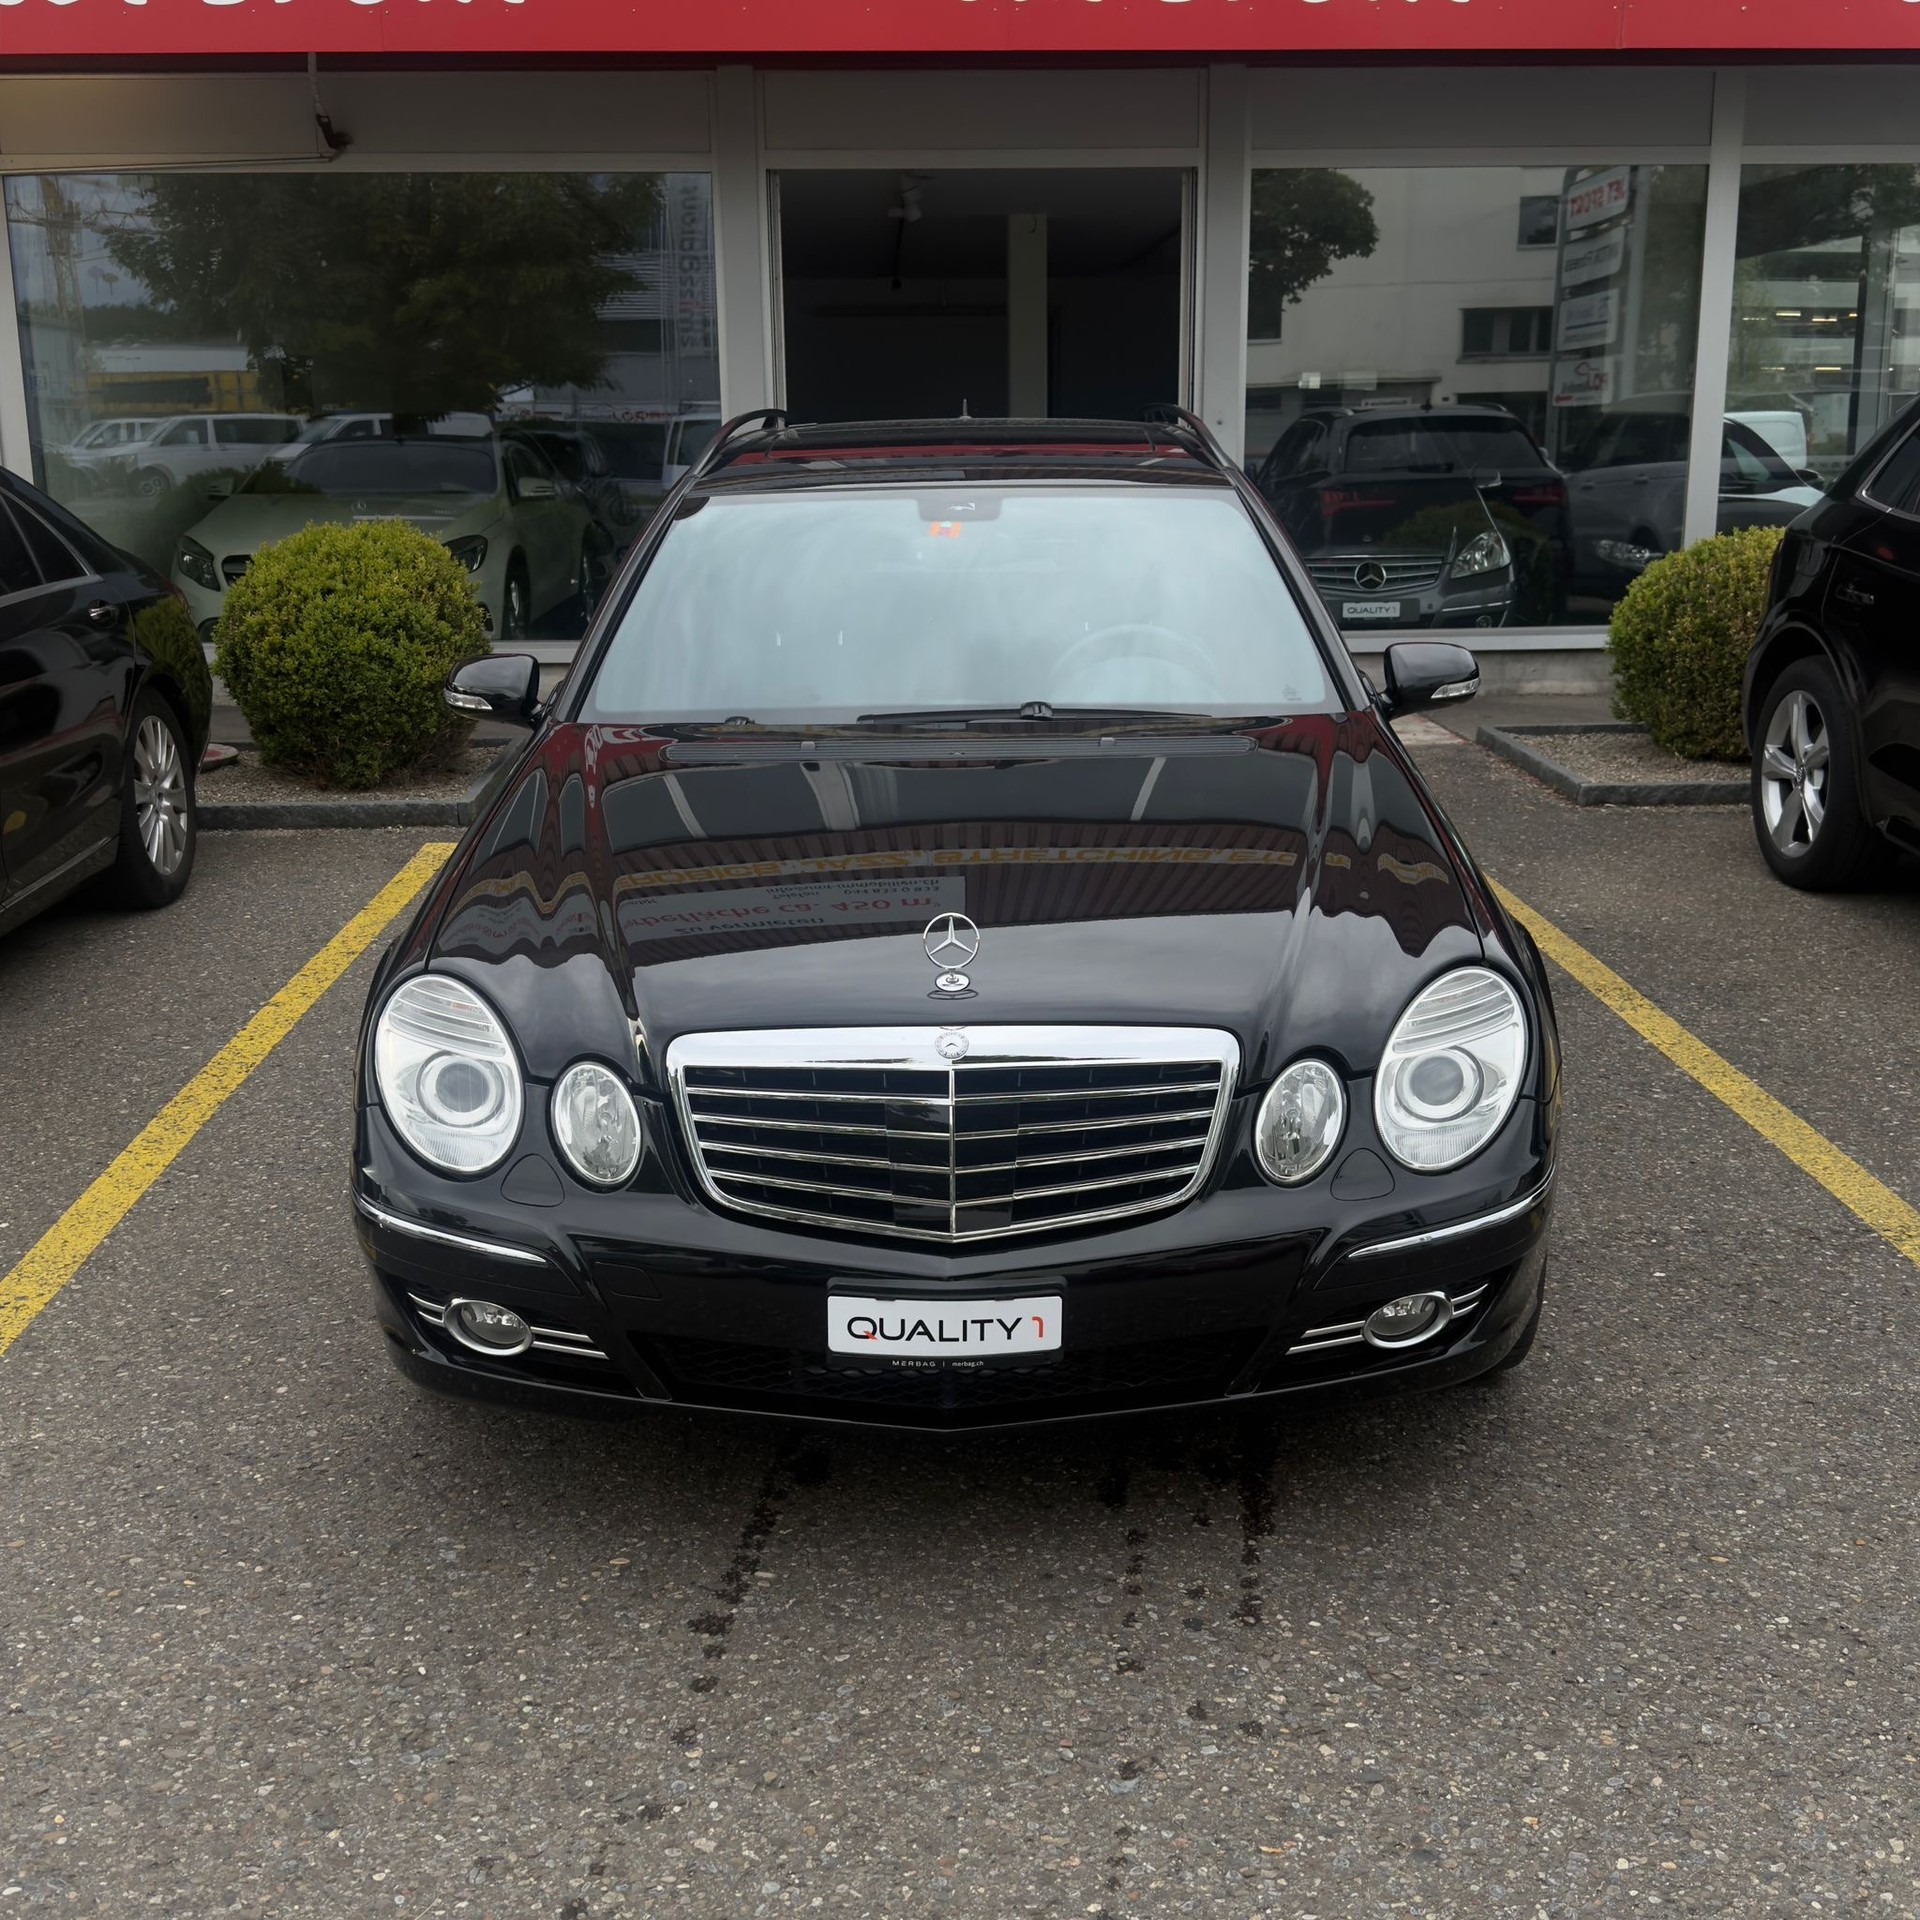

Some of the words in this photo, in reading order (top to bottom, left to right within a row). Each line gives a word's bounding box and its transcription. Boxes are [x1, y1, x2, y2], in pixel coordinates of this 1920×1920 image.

[1347, 606, 1391, 614] QUALITY
[847, 1316, 1023, 1342] QUALITY
[1031, 1315, 1045, 1338] 1
[951, 1360, 984, 1368] merbag.ch
